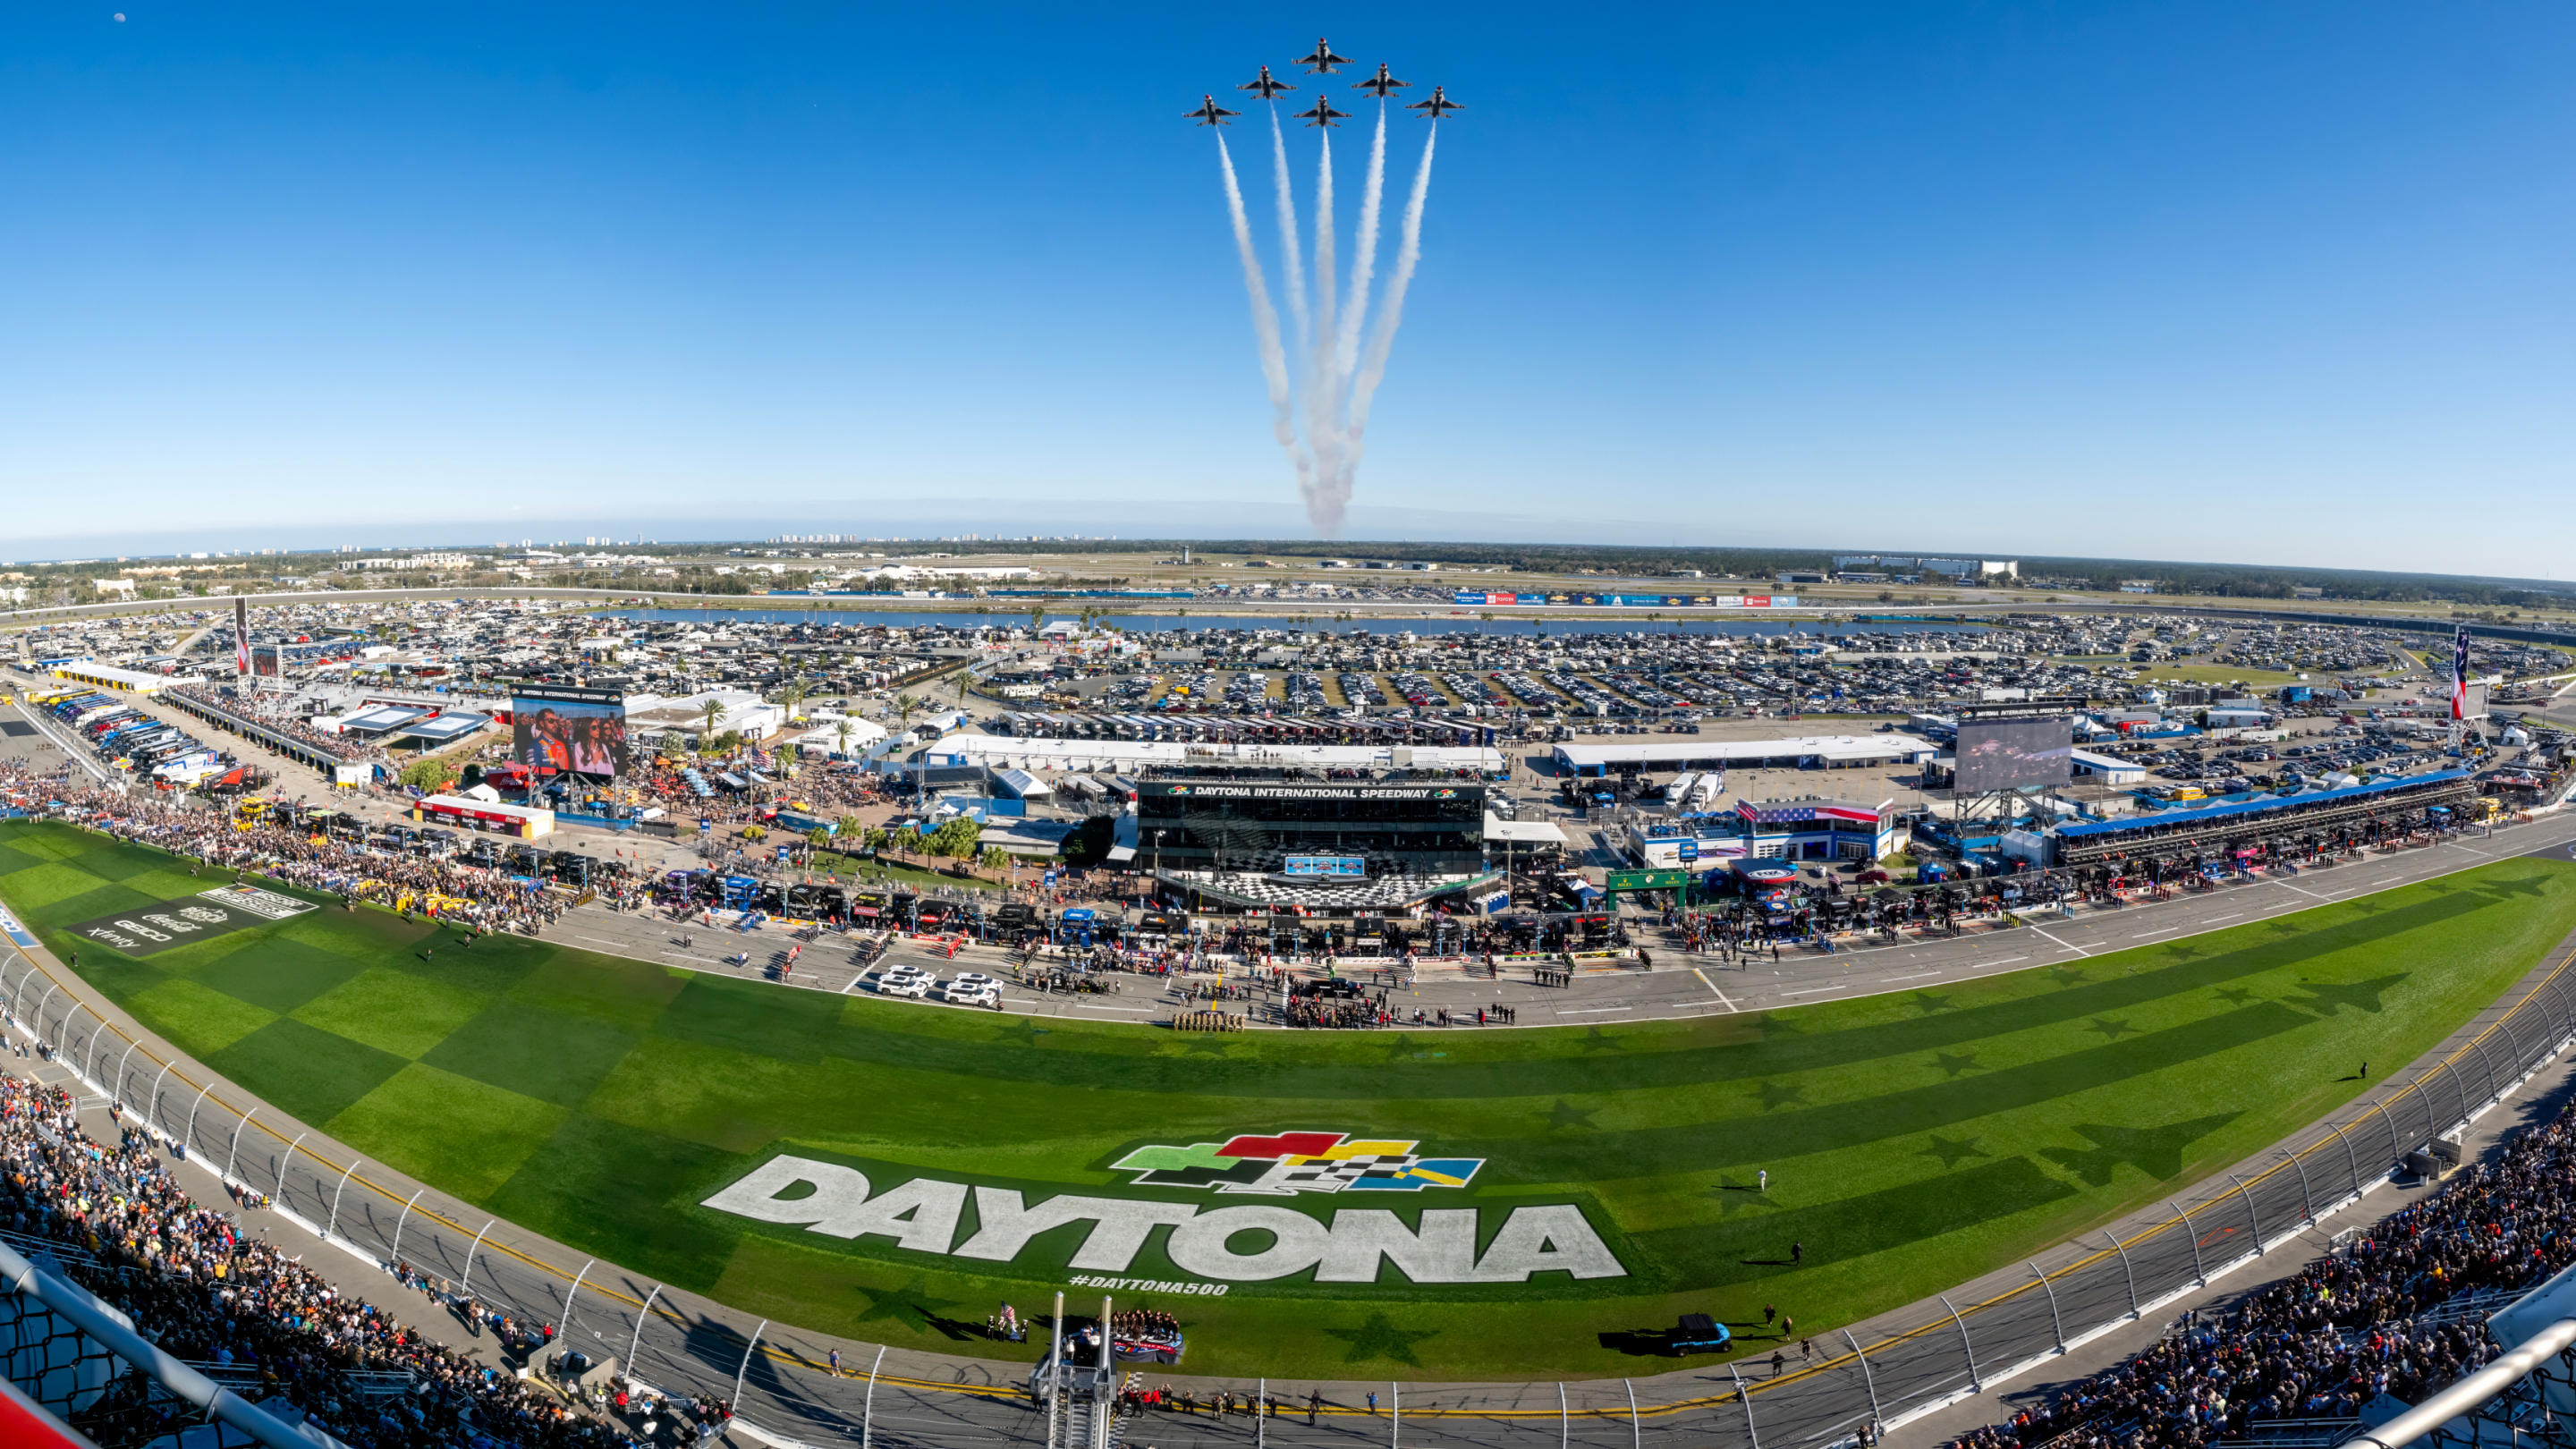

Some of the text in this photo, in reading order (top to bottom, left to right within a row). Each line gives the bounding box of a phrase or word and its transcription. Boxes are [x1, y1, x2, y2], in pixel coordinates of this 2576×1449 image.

[544, 691, 580, 699] INTERNATIONAL
[1195, 785, 1430, 799] DAYTONA INTERNATIONAL SPEEDWAY
[462, 809, 476, 818] Coca-Cola
[505, 815, 521, 825] Coca-Cola
[87, 928, 140, 948] xfinity
[114, 920, 173, 942] GEICO
[702, 1155, 1626, 1283] DAYTONA
[1069, 1275, 1229, 1296] #DAYTONA500
